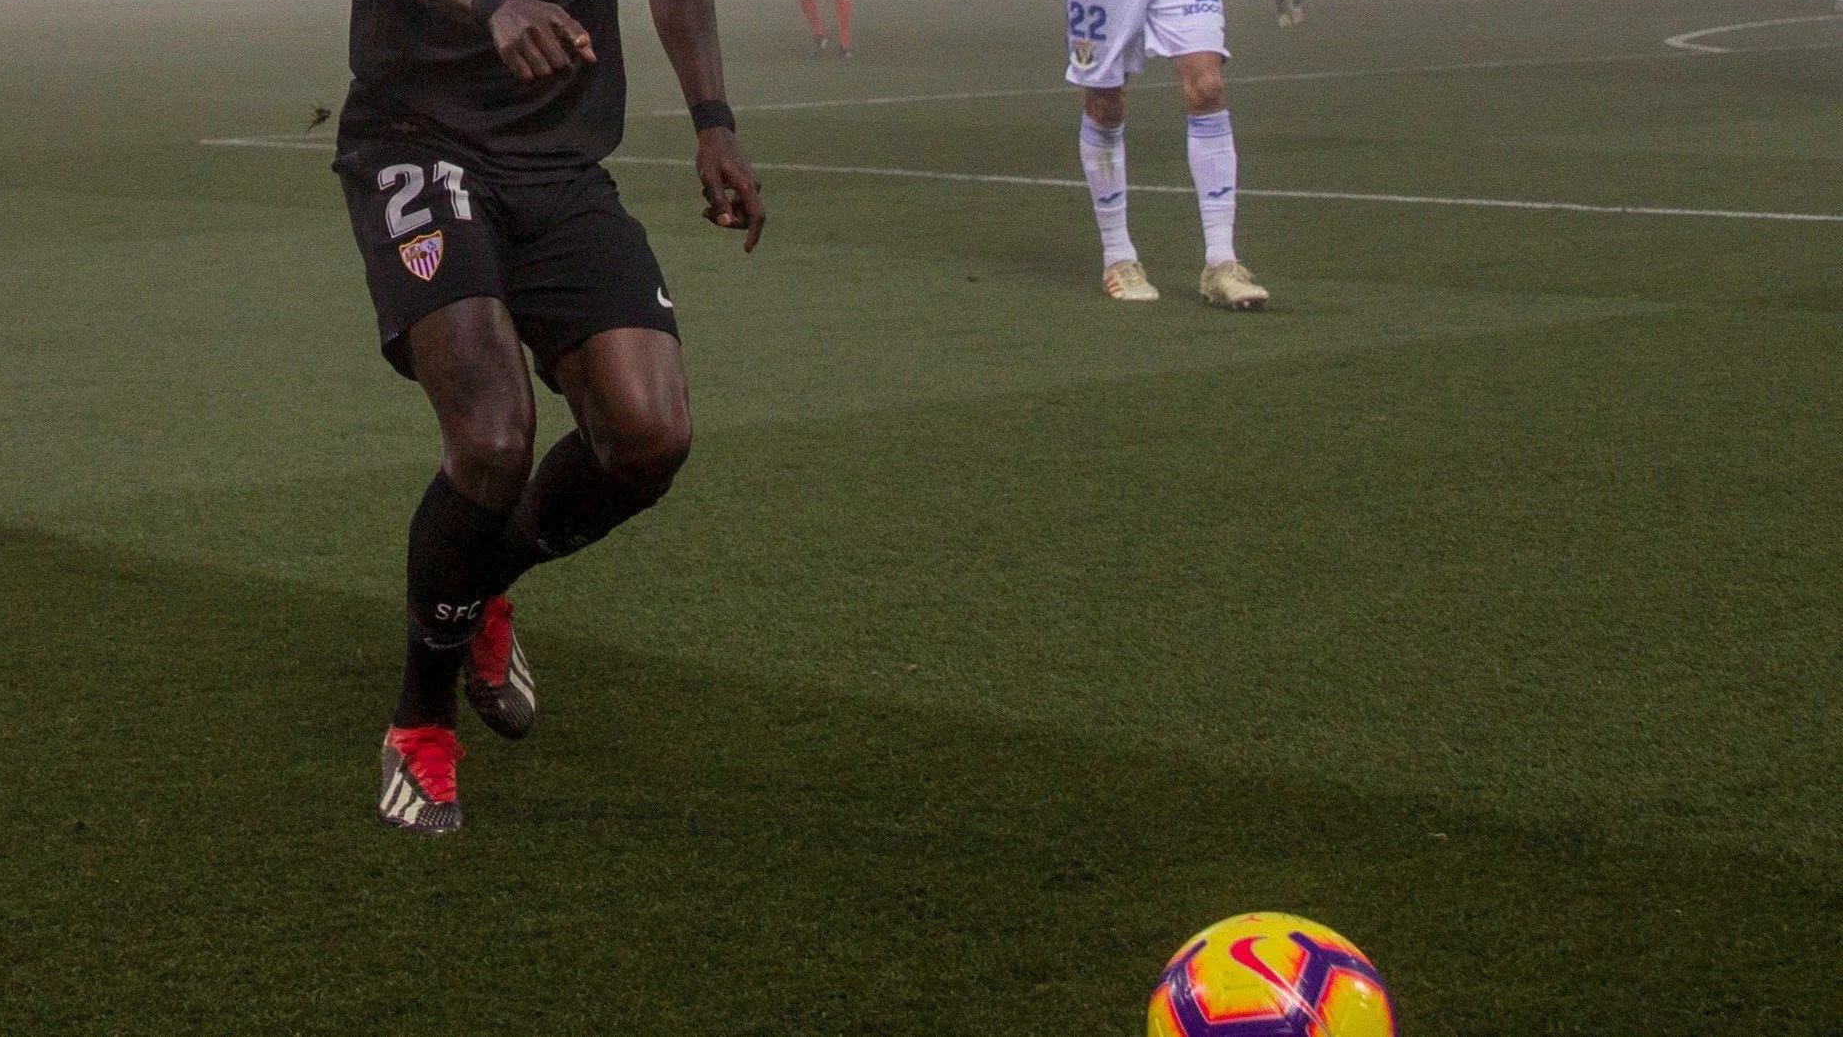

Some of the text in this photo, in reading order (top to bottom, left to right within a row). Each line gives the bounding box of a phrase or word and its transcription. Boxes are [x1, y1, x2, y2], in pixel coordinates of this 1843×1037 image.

[1070, 0, 1107, 41] 22
[377, 160, 473, 239] 21
[434, 599, 482, 623] SFC
